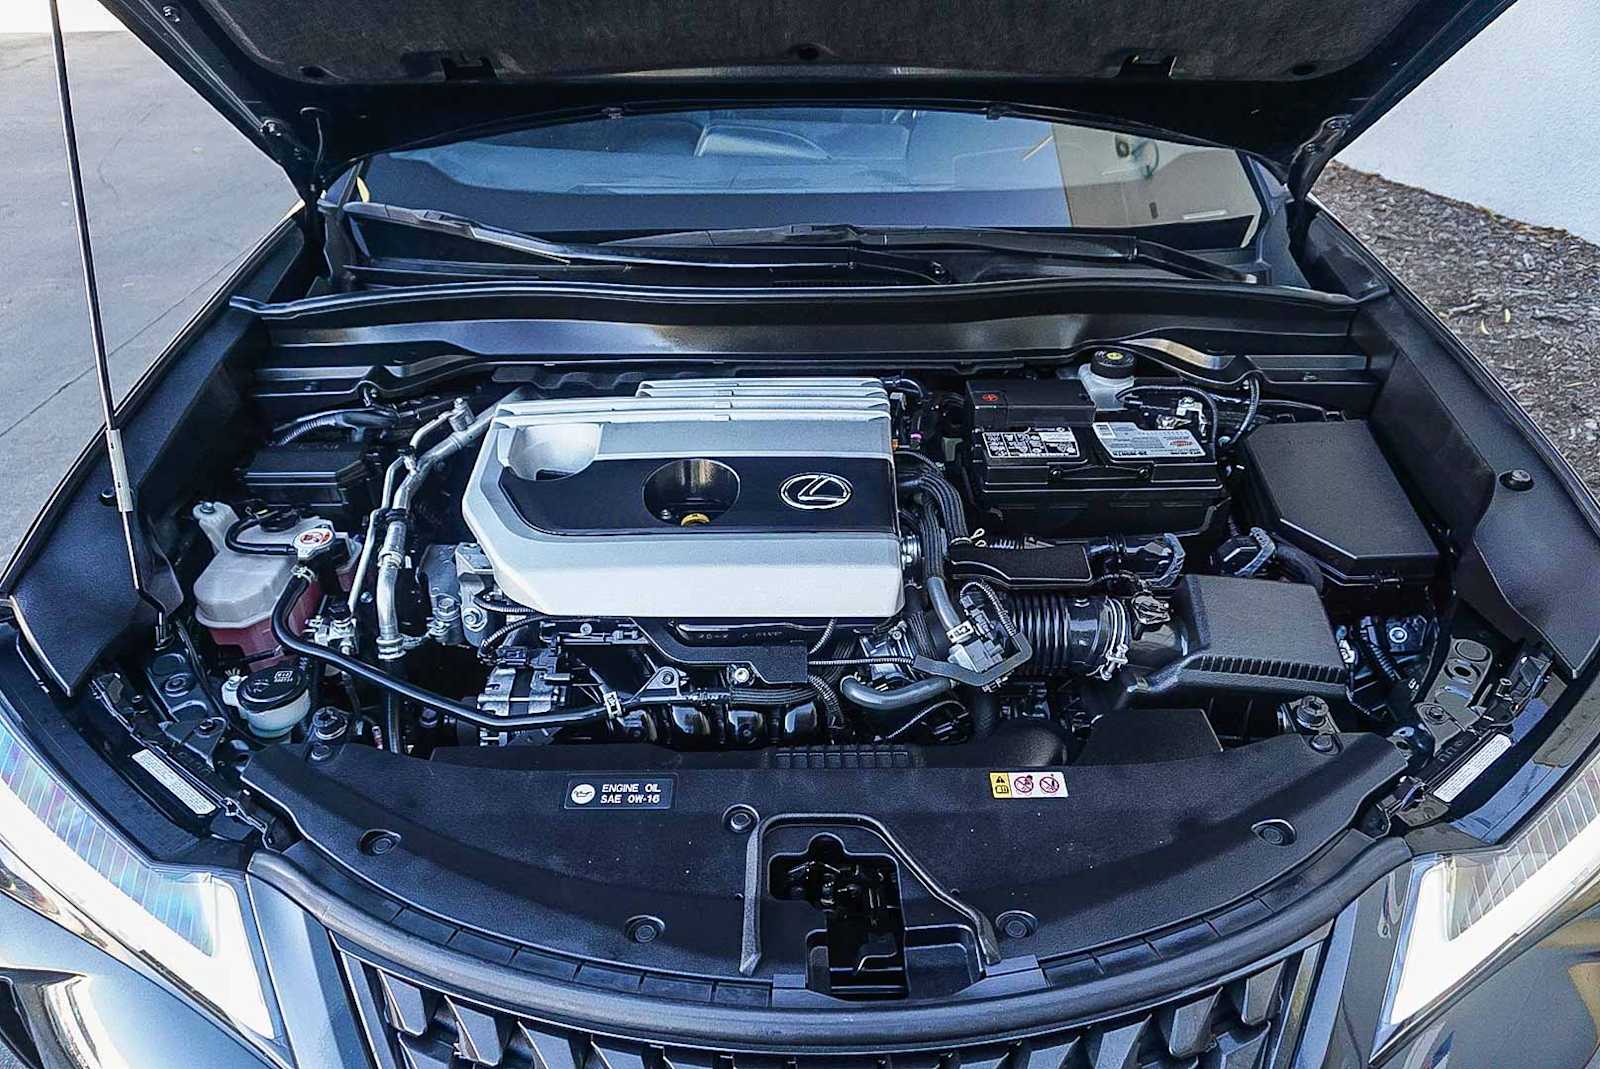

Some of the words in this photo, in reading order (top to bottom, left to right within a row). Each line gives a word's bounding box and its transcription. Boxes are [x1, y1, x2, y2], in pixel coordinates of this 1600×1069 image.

[601, 783, 640, 793] ENGINE
[644, 783, 662, 793] OIL
[600, 794, 622, 804] SAE
